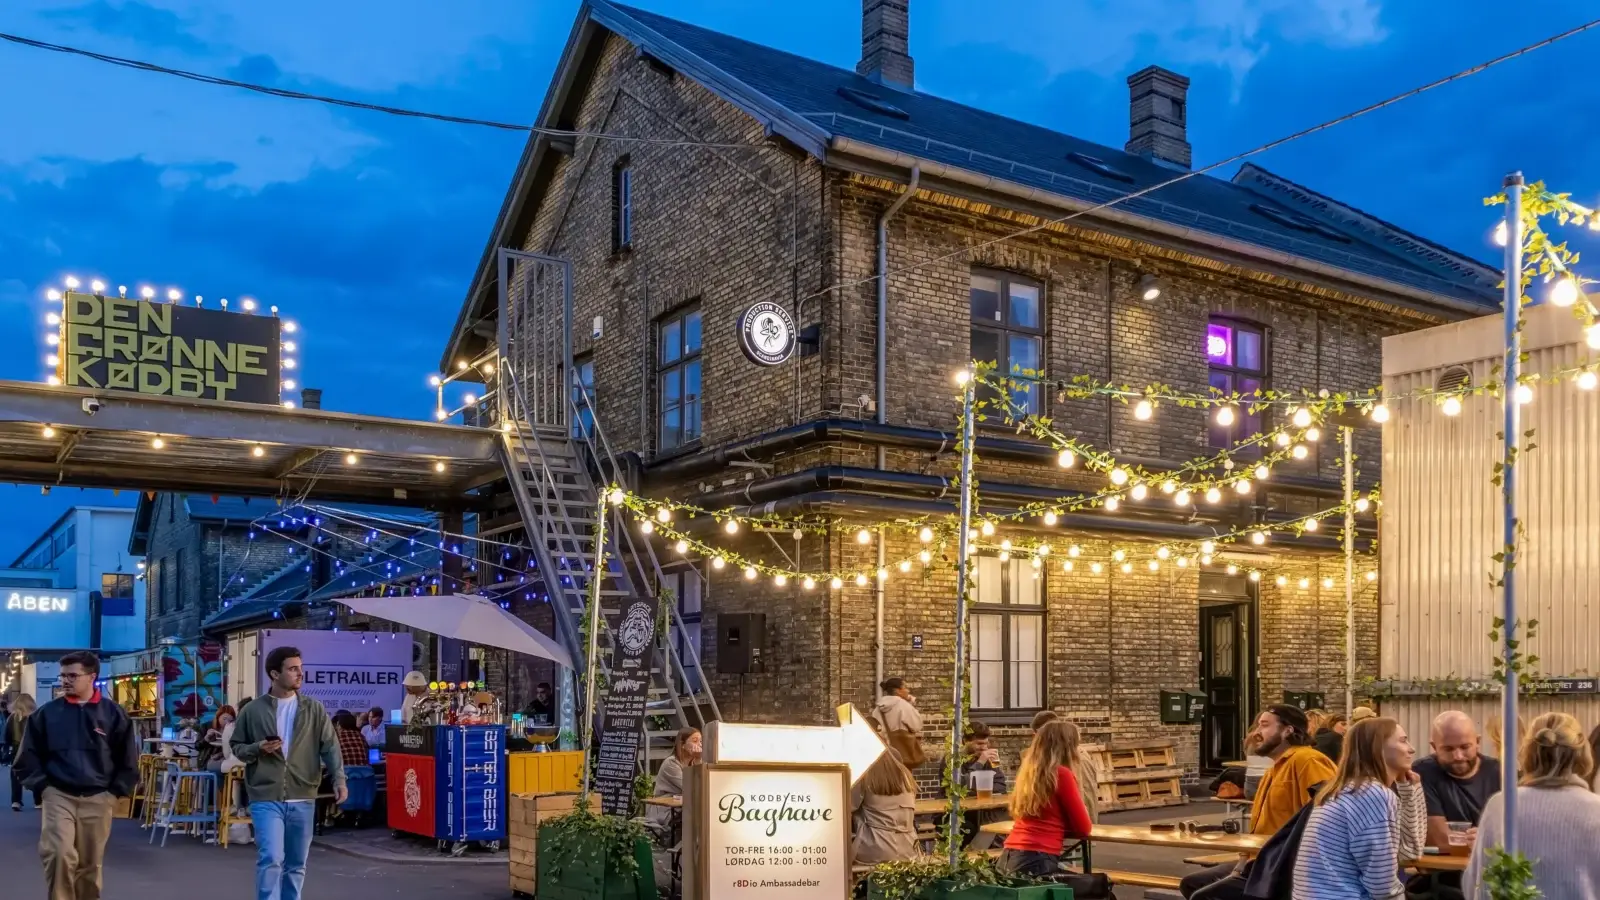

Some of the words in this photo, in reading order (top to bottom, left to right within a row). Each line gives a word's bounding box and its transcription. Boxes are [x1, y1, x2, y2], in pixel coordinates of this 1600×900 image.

[67, 291, 172, 336] DEN
[745, 304, 773, 332] PRODUCTION
[774, 306, 794, 334] SERVICE
[67, 323, 268, 376] GRØNNE
[67, 355, 238, 402] KØDBY
[7, 593, 68, 611] ÅBEN
[302, 671, 398, 685] LETRAILER
[483, 730, 498, 785] BETTER
[483, 788, 497, 832] BEER
[718, 793, 833, 837] Baghave
[725, 846, 765, 854] TOR-FRE
[768, 846, 793, 854] 16:00
[802, 846, 827, 854] 01:00
[725, 857, 765, 866] LØRDAG
[768, 857, 793, 866] 12:00
[802, 857, 828, 865] 01:00
[732, 879, 758, 888] r8Dio
[760, 879, 821, 888] Ambassadebar
